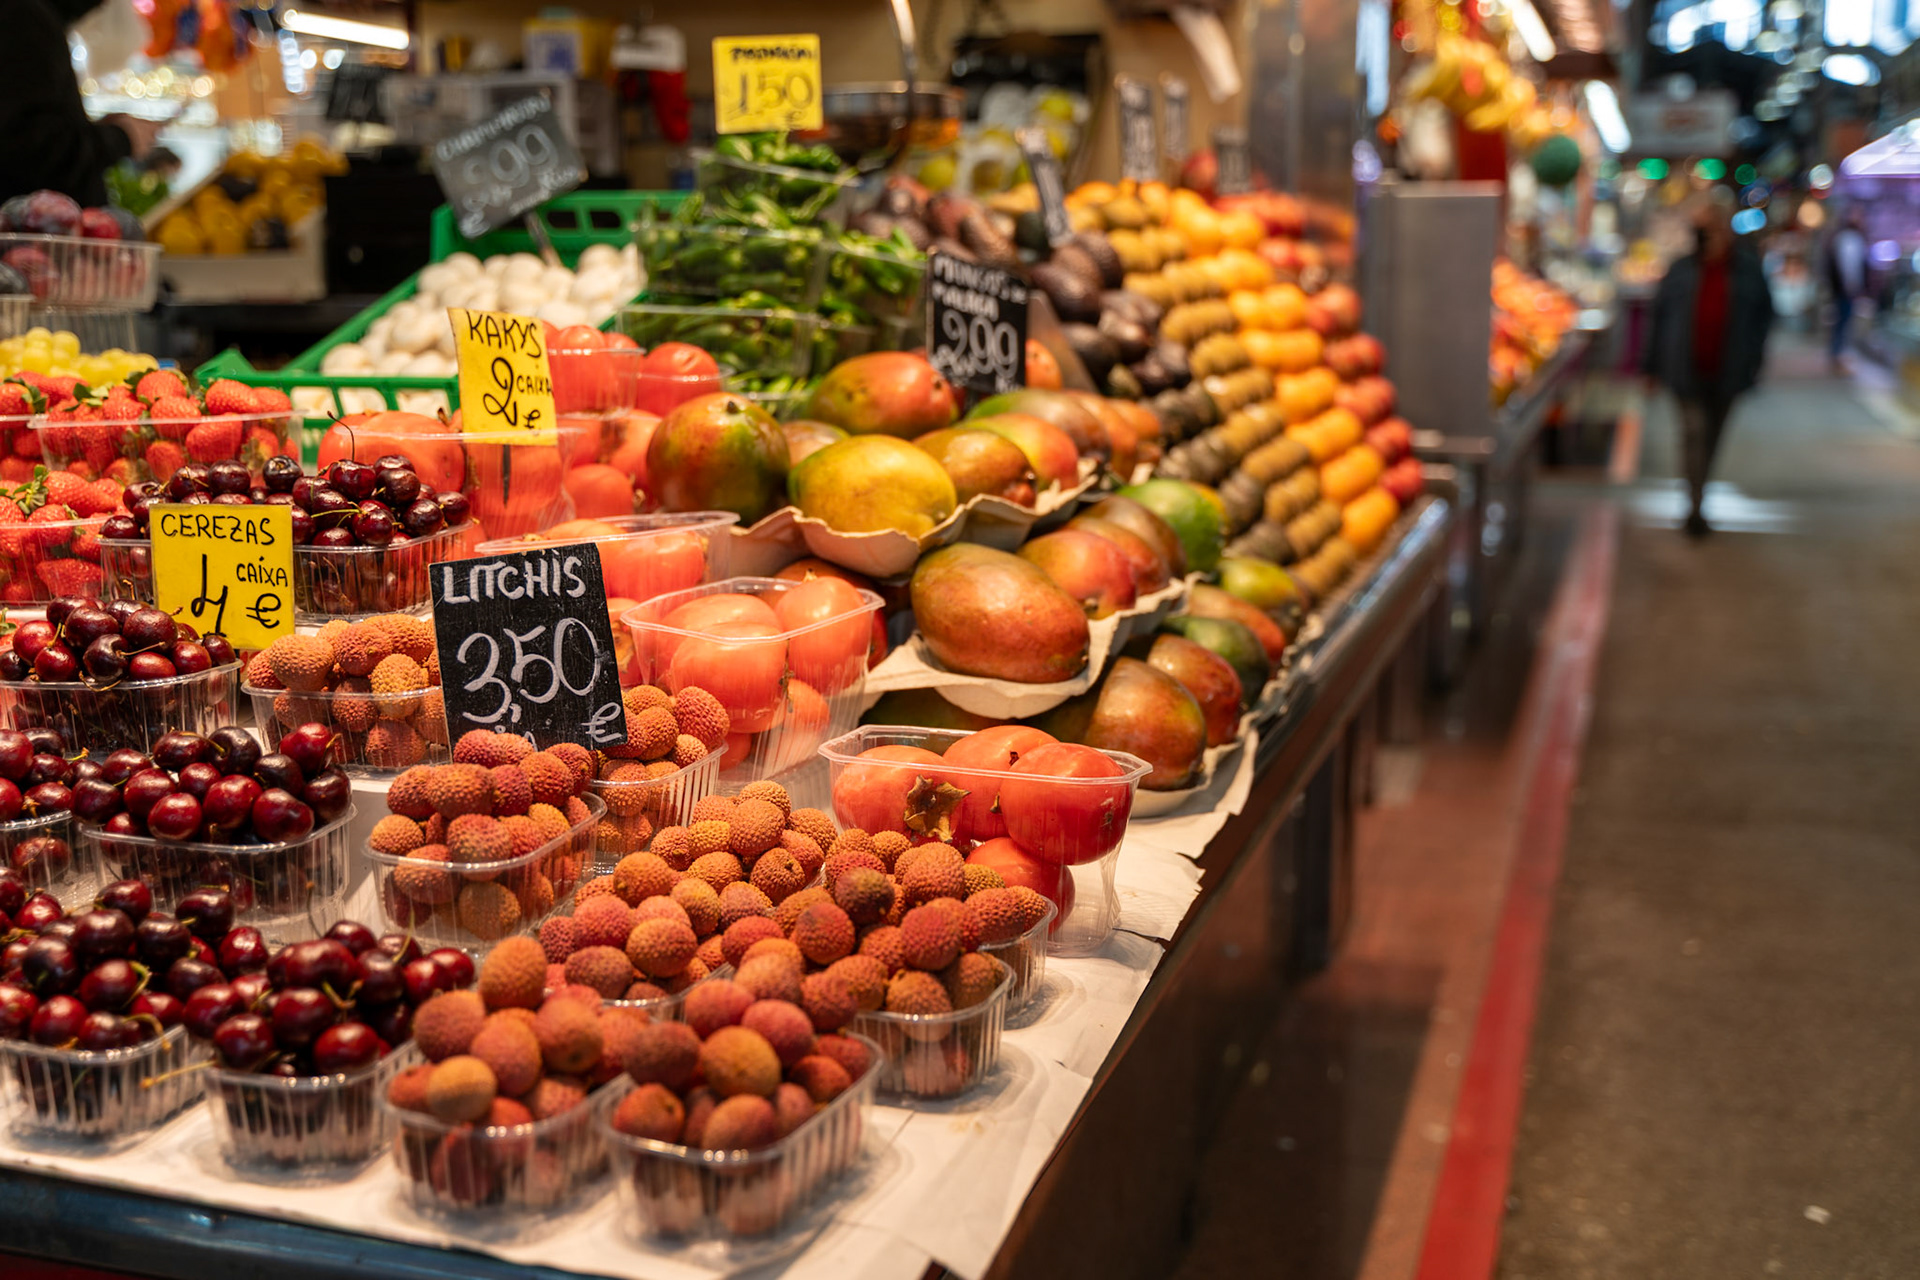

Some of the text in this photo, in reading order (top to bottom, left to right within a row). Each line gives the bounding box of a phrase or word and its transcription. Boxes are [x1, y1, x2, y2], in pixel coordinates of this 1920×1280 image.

[465, 311, 541, 358] KAKYS
[483, 357, 517, 426] 2
[161, 514, 275, 545] CEREZAS
[236, 556, 288, 587] CAIXA
[443, 549, 586, 604] LITCHIS
[191, 554, 281, 637] 4 €
[581, 702, 622, 743] €
